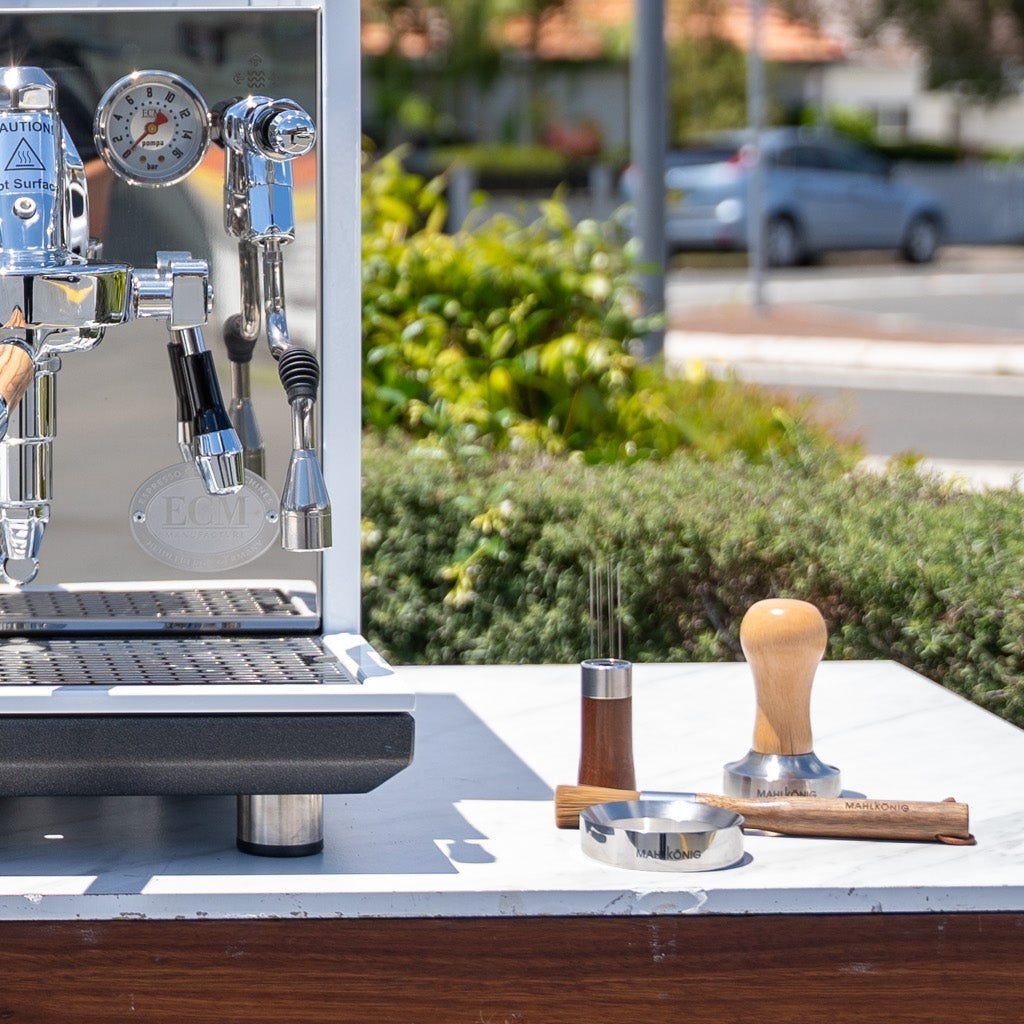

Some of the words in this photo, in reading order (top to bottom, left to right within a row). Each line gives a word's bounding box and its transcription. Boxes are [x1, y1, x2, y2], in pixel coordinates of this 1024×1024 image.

[146, 87, 153, 98] 8
[165, 91, 176, 103] 10
[125, 95, 135, 105] 6
[112, 113, 123, 122] 4
[179, 107, 191, 119] 12
[112, 134, 123, 143] 2
[181, 129, 193, 140] 14
[141, 140, 164, 148] pompa
[171, 147, 184, 159] 16
[162, 495, 250, 527] ECM
[636, 846, 702, 860] MAHKÖNIG
